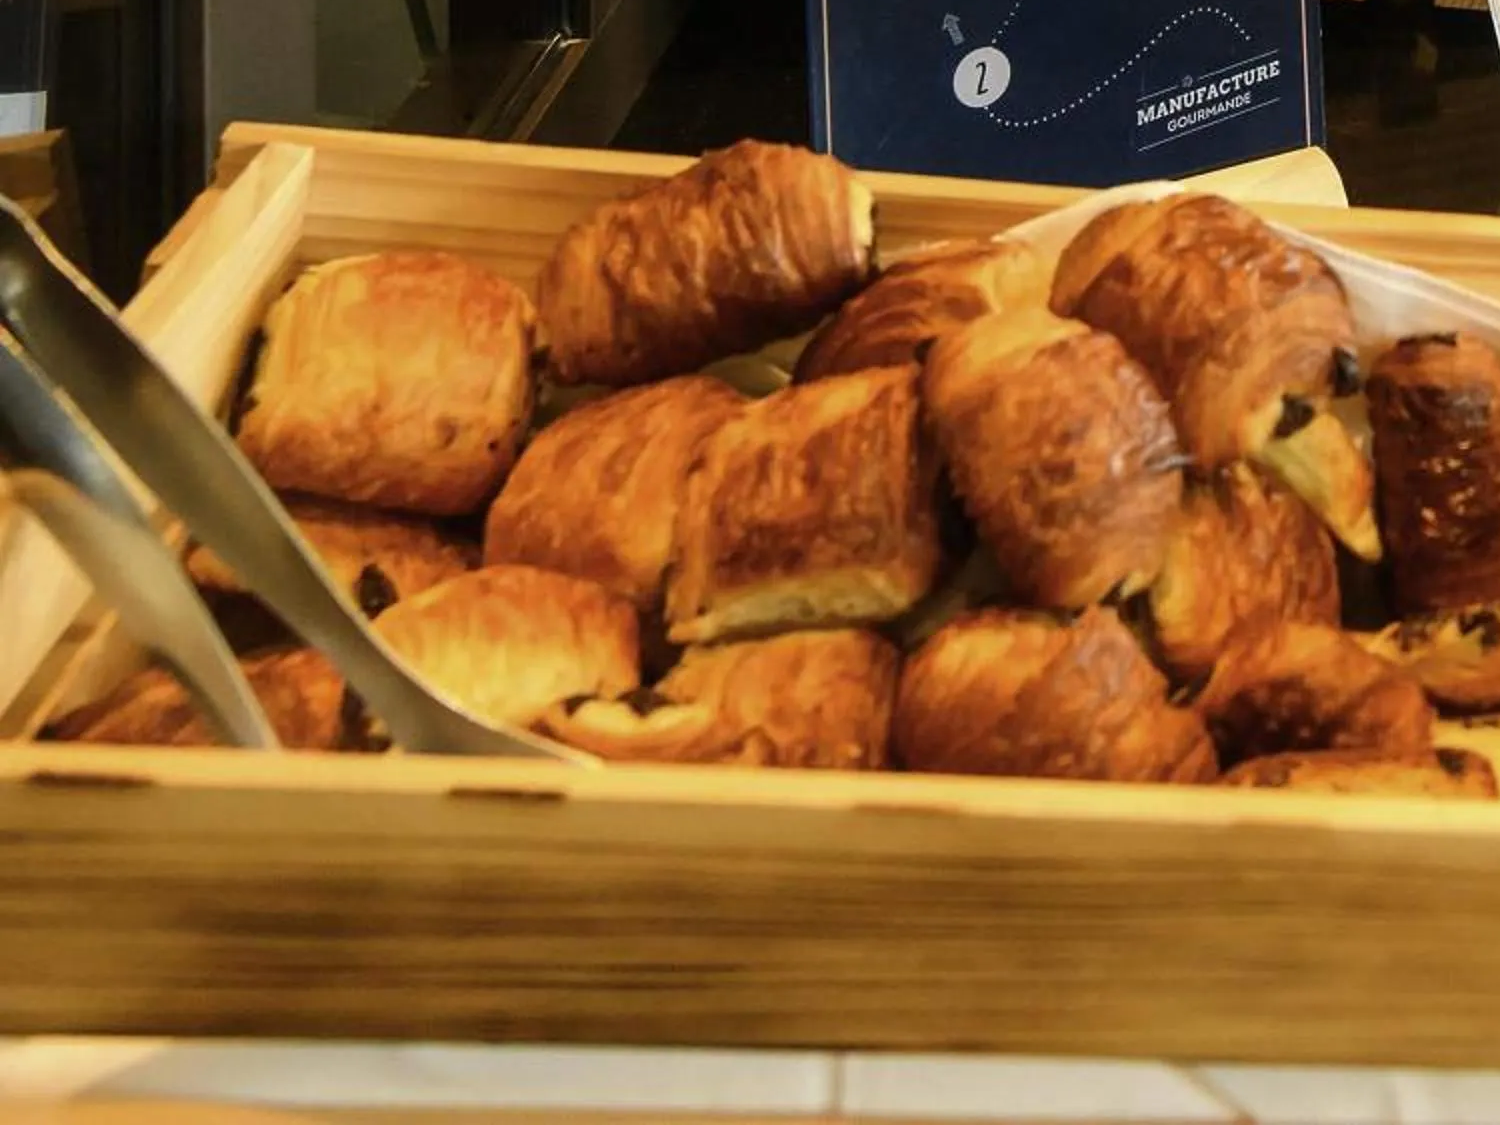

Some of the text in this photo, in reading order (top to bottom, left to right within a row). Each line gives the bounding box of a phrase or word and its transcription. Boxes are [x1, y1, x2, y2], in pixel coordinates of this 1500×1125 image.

[975, 61, 990, 96] 2
[1136, 60, 1281, 126] MANUFACTURE
[1166, 91, 1252, 133] GOURMANDE
